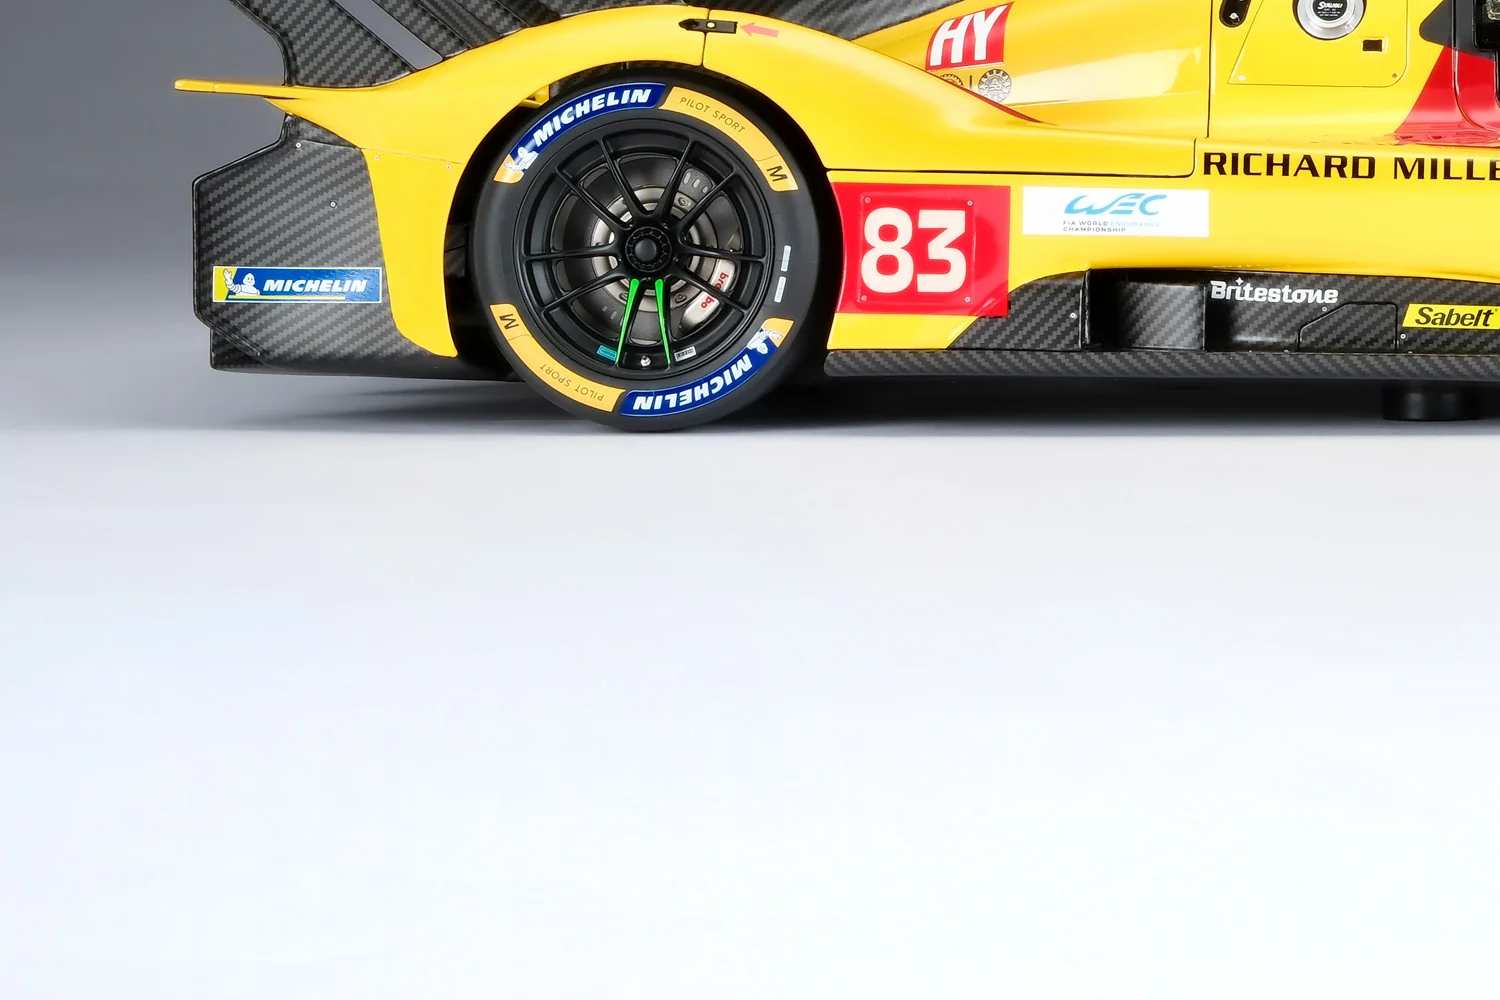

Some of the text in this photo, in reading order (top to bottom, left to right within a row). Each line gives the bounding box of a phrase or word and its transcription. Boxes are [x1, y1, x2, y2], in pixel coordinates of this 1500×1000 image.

[929, 4, 1008, 67] HY
[532, 88, 652, 148] MICHELIN
[679, 96, 746, 133] PILOT SPORT
[766, 165, 788, 182] M
[1203, 151, 1376, 179] RICHARD
[1064, 192, 1168, 216] WEC
[860, 207, 967, 294] 83
[263, 279, 368, 293] MICHELIN
[700, 271, 729, 309] brebo
[1210, 277, 1339, 304] Britestone
[499, 313, 520, 330] M
[1415, 306, 1494, 327] Sabelt
[539, 363, 605, 402] PILOT SPORT
[633, 353, 753, 411] MICHELIN
